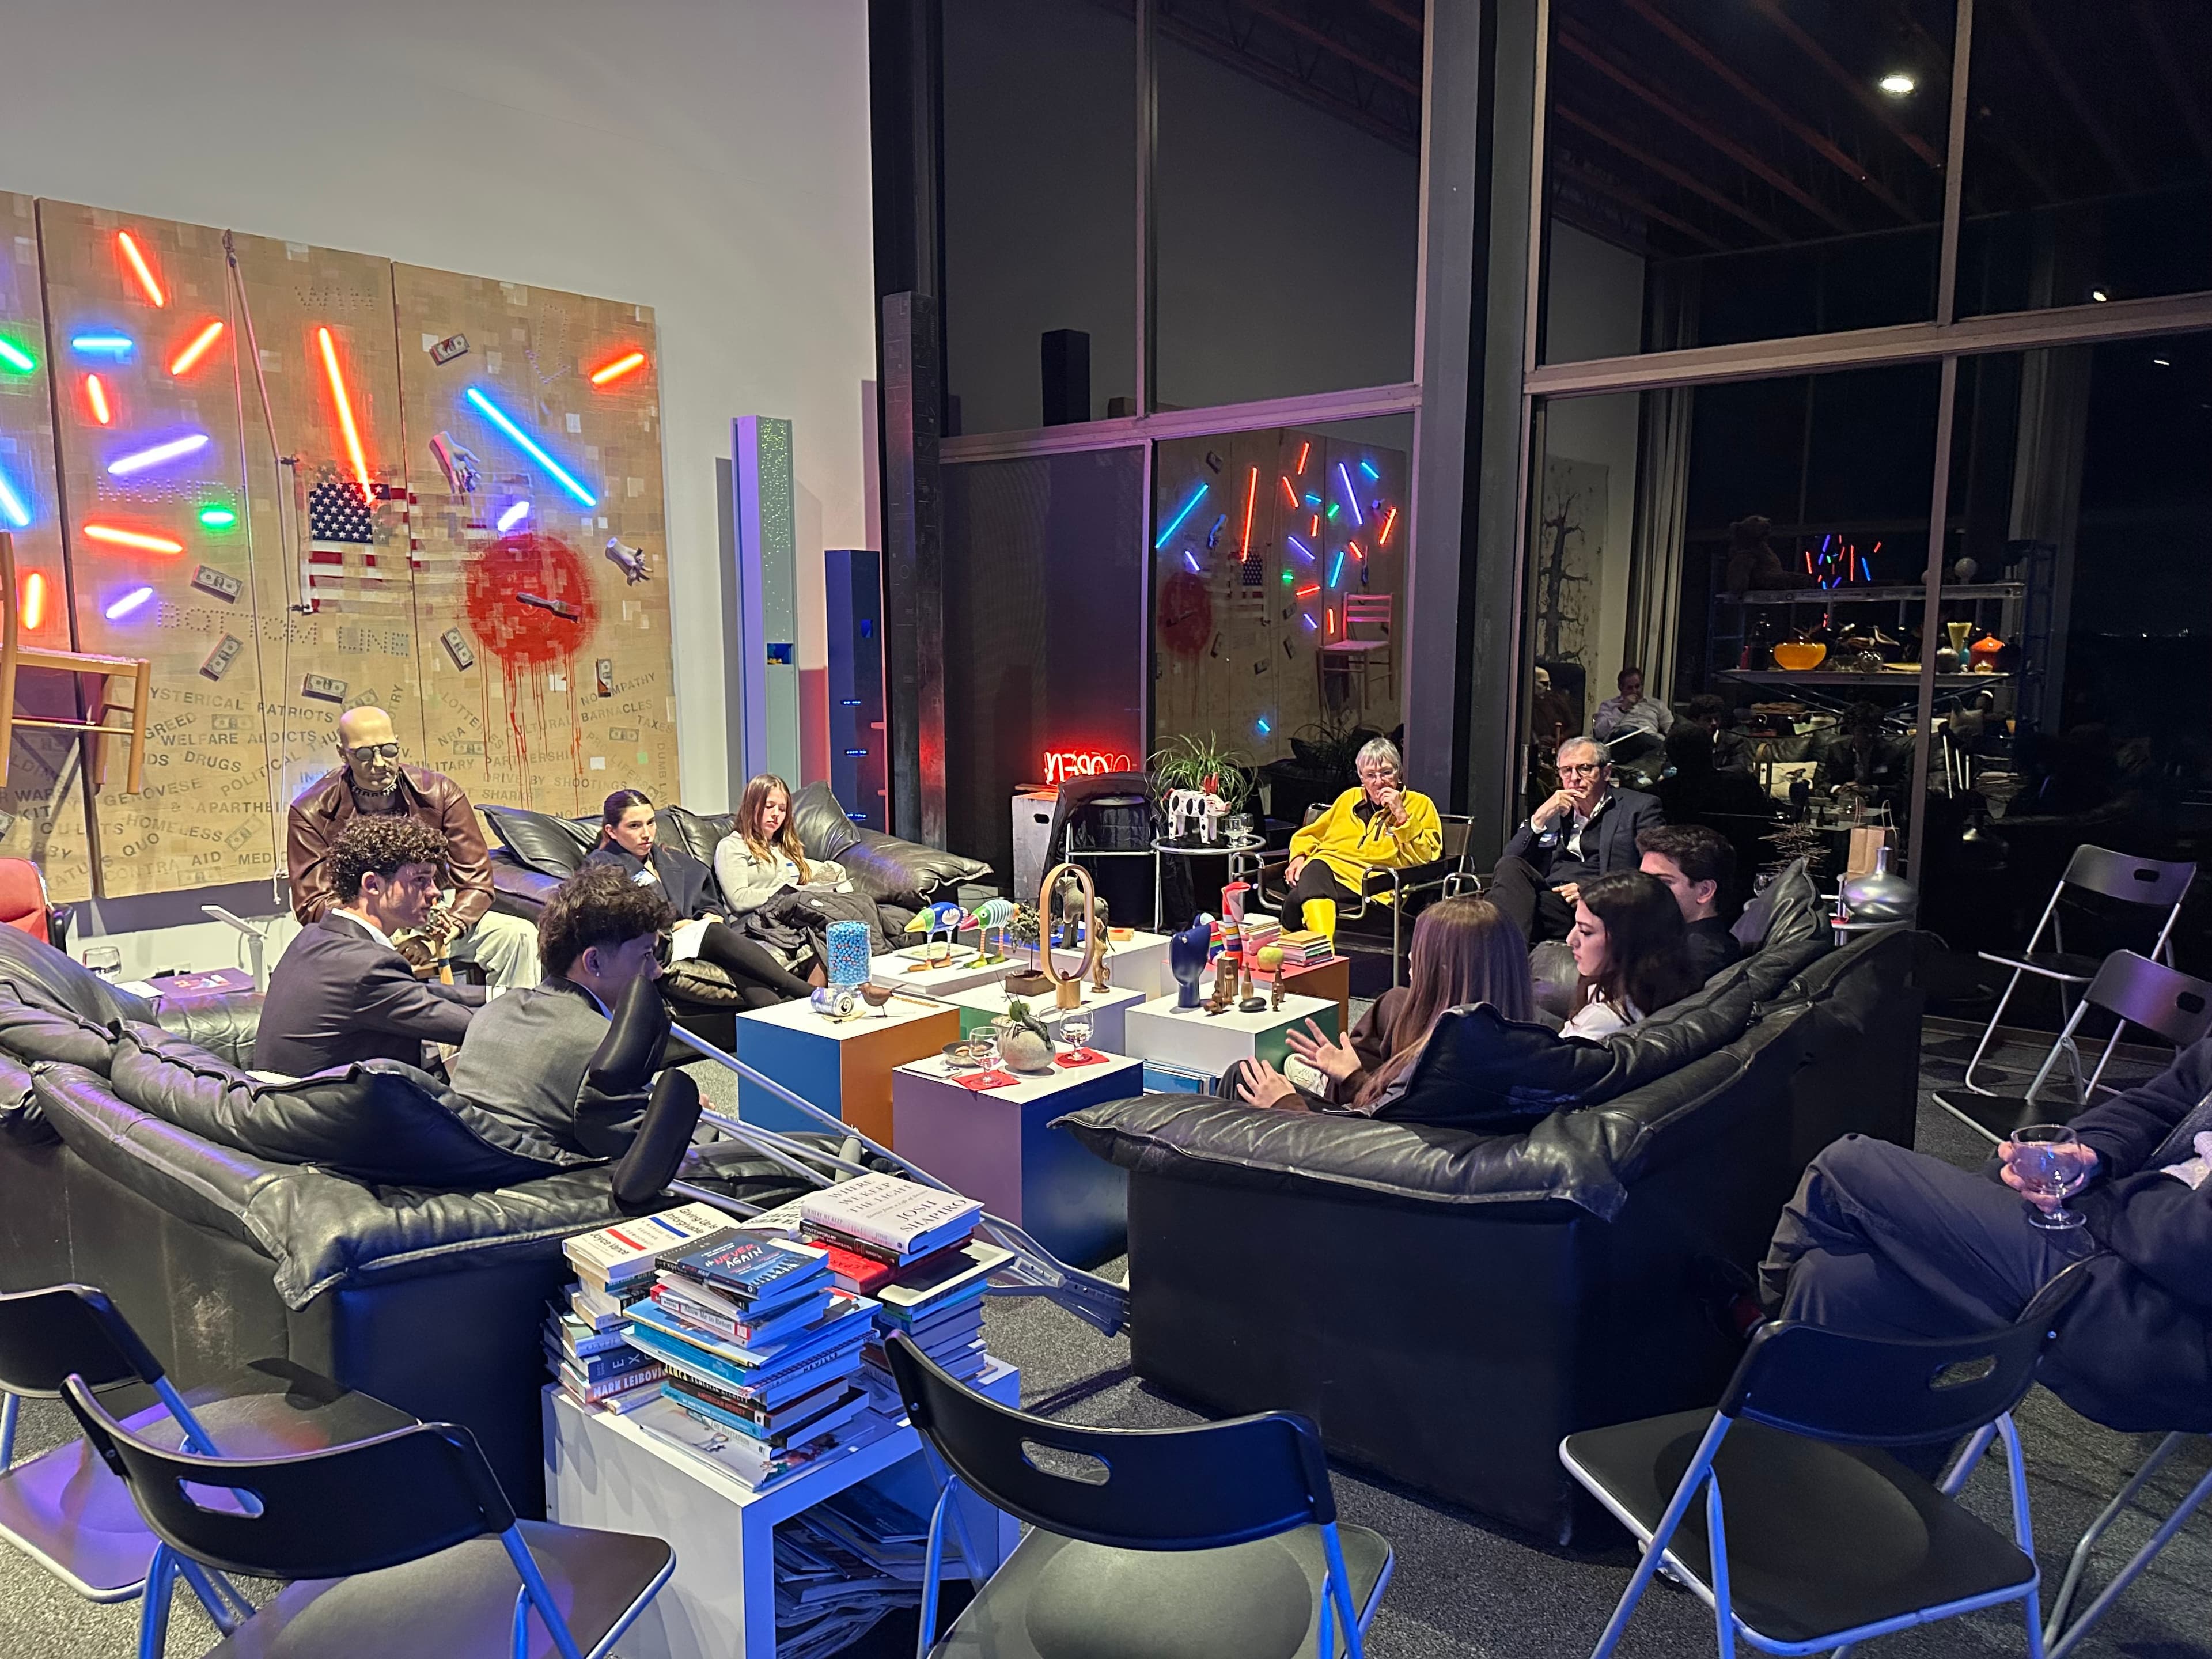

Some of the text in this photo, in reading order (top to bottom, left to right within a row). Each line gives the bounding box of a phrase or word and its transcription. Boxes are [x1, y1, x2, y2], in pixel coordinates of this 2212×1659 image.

[97, 476, 245, 506] MONEY
[157, 600, 410, 657] BOTTOM LINE
[611, 672, 656, 696] MPATHY
[150, 687, 335, 724] YSTERICAL PATRIOTS
[581, 699, 653, 722] BARNACLES
[144, 711, 198, 740] GREED
[441, 692, 505, 750] LOTTERES
[637, 715, 673, 734] TAXES
[161, 730, 317, 747] WELFARE ADDCTS
[437, 726, 467, 747] NRA
[184, 750, 242, 772] DRUGS
[486, 749, 575, 768] PARTNERSHI
[657, 743, 667, 779] DUMB
[220, 752, 302, 797] POLITCAL
[554, 776, 627, 791] SHOOTINGS
[104, 778, 202, 808] GENOVESE
[126, 813, 224, 842] HOMELESS
[122, 832, 160, 857] QUO
[192, 850, 222, 866] AID
[828, 1180, 876, 1199] WHERE
[861, 1182, 892, 1197] KEEP
[873, 1184, 912, 1202] LIGHT
[896, 1199, 937, 1222] JOSH
[900, 1200, 968, 1232] SHAPIRO
[726, 1247, 763, 1268] AGAIN
[593, 1380, 621, 1398] MARK
